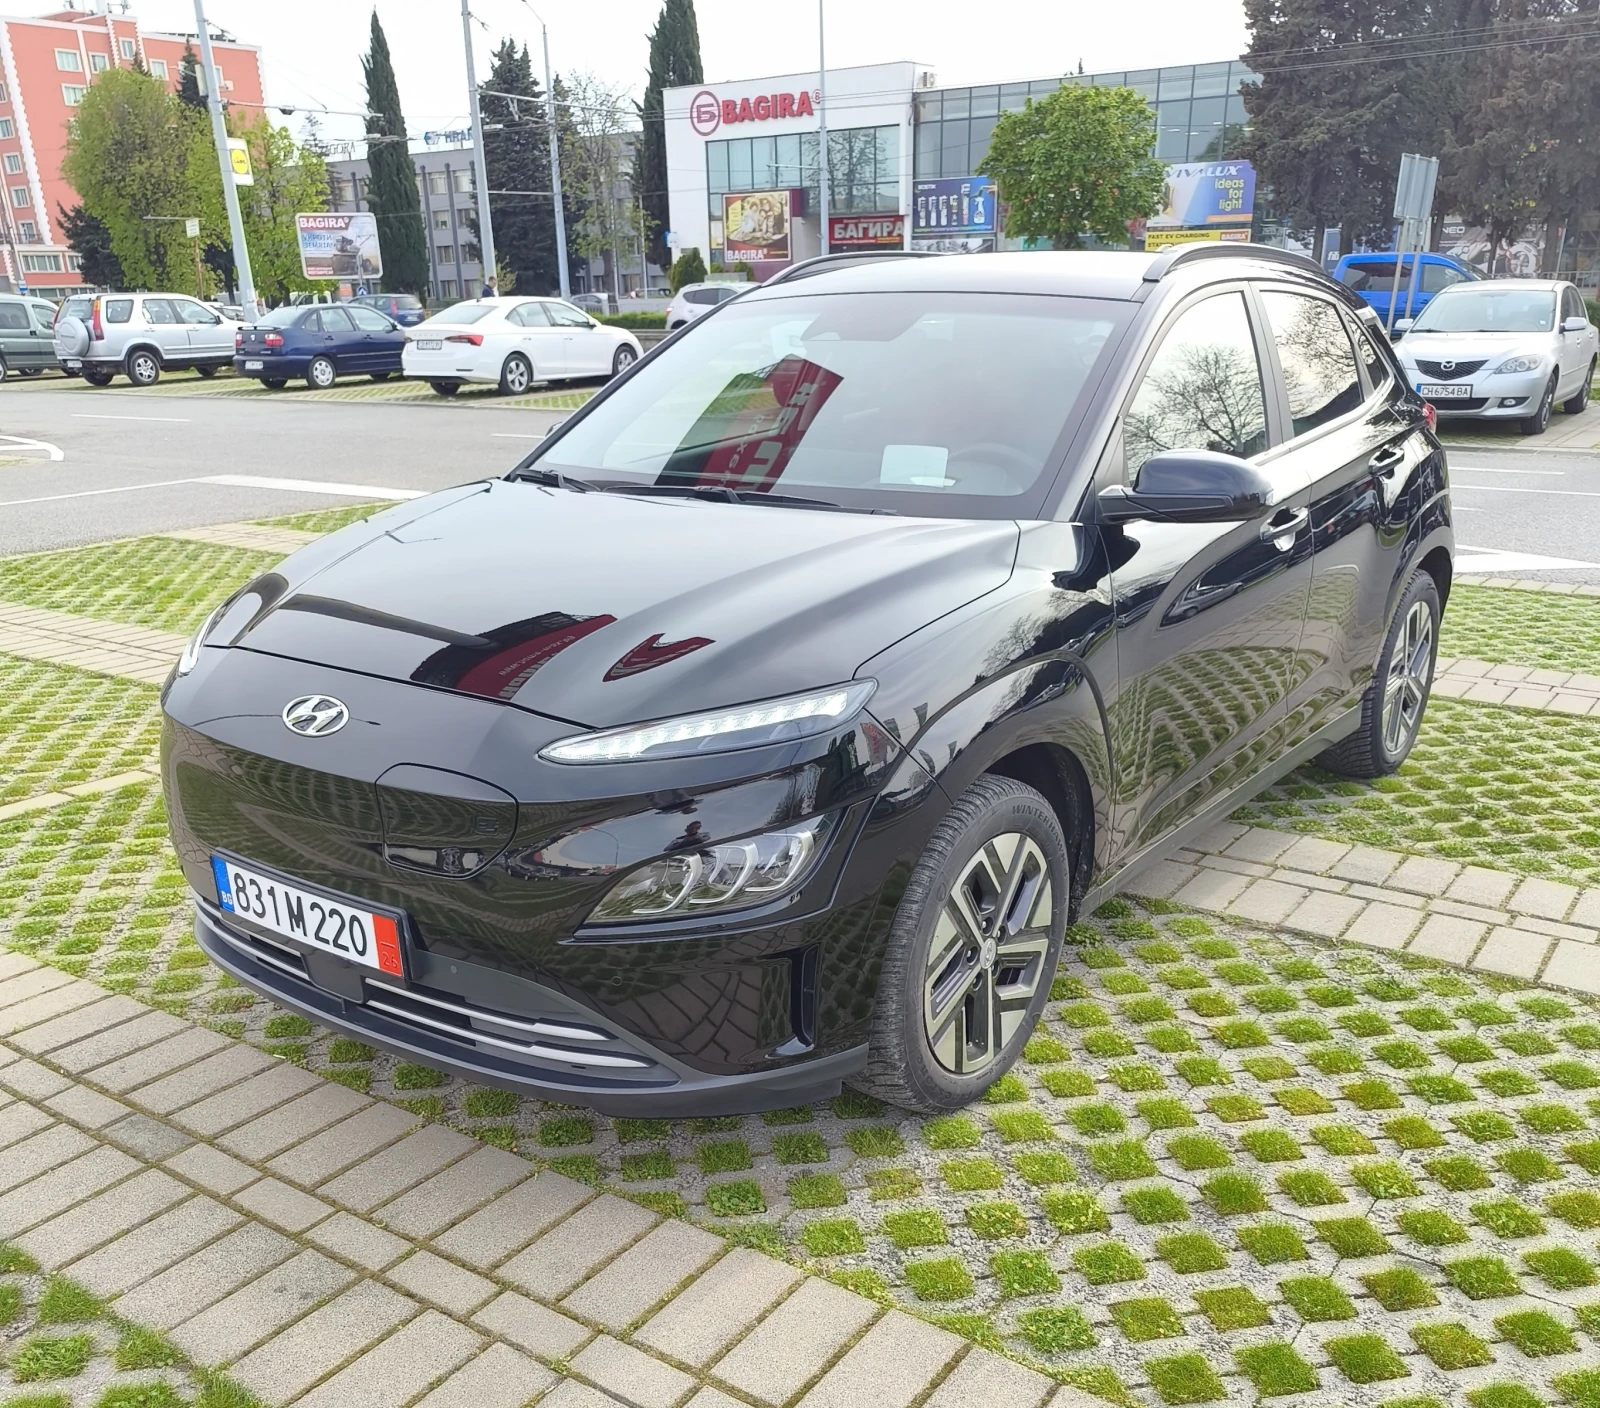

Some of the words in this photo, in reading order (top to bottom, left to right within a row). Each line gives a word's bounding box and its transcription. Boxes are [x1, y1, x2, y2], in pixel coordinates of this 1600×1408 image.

[722, 91, 813, 124] BAGIRA
[1215, 179, 1244, 189] ideas
[1228, 189, 1244, 199] for
[1218, 199, 1242, 212] light
[300, 217, 346, 228] BAGIRA
[833, 221, 904, 239] БАГИРА
[727, 249, 764, 260] BAGIRA
[222, 890, 233, 904] BG
